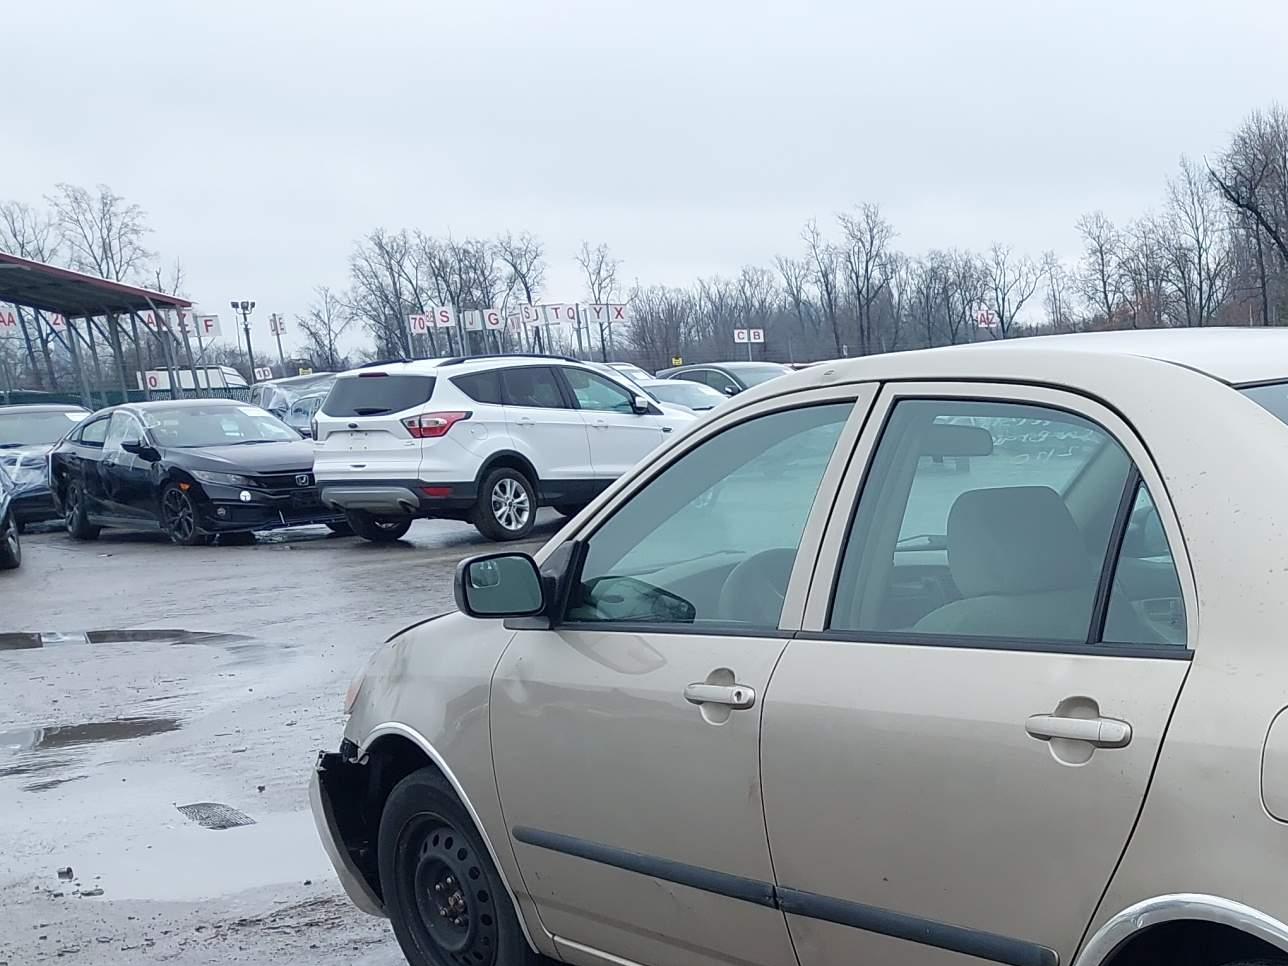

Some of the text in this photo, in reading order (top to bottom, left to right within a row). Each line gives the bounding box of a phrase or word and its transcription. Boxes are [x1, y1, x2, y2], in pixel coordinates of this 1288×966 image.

[440, 310, 450, 323] S
[488, 312, 499, 326] G
[552, 307, 560, 320] T
[567, 307, 576, 320] Q
[594, 307, 602, 320] Y
[614, 307, 624, 320] X
[204, 319, 213, 333] F
[411, 317, 425, 330] 70
[737, 331, 745, 340] C
[753, 331, 761, 340] B
